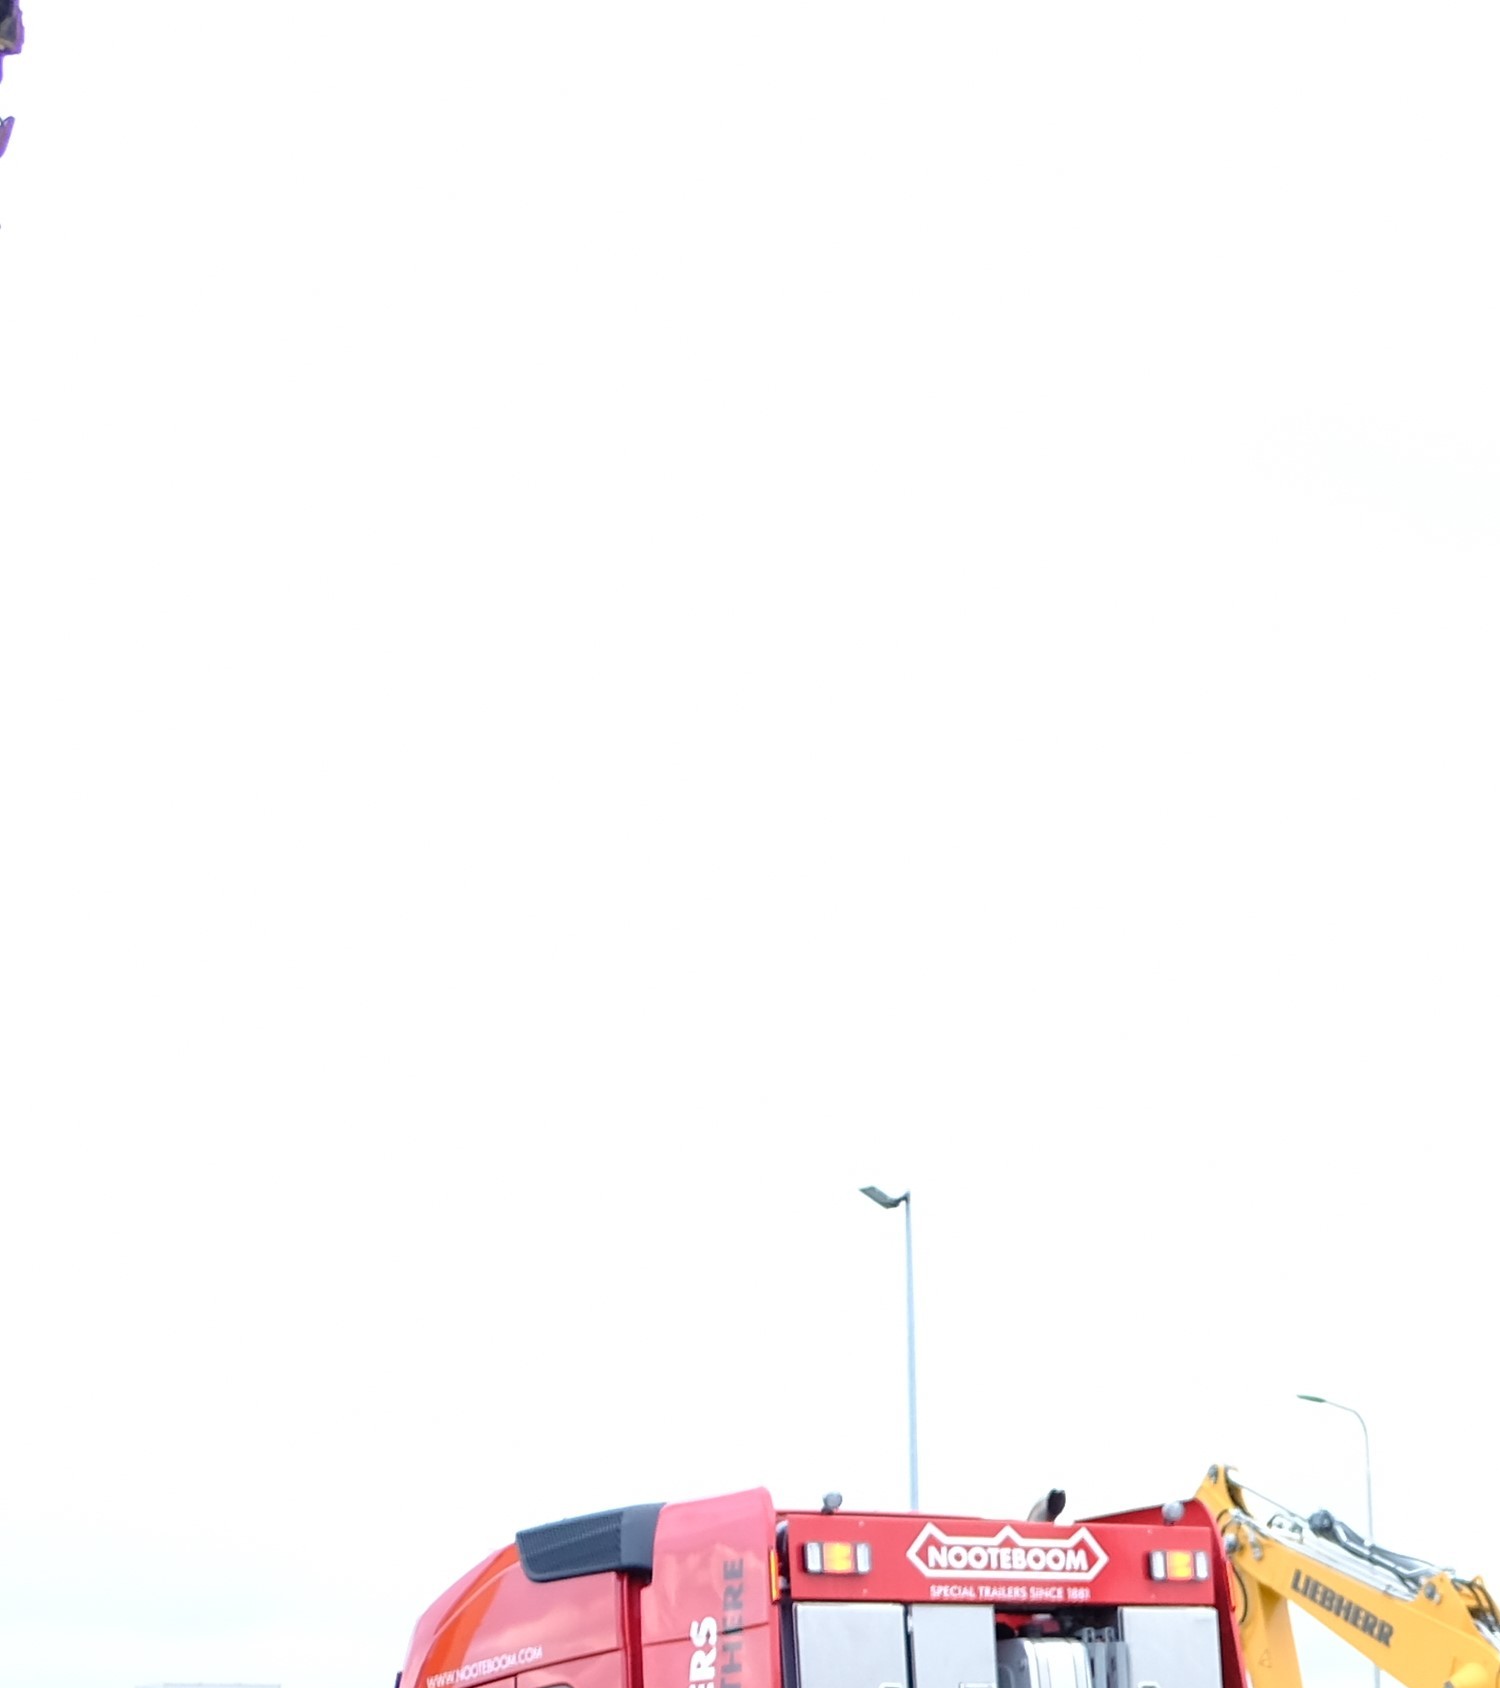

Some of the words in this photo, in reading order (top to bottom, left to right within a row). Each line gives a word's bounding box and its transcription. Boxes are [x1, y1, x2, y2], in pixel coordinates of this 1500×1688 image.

[927, 1545, 1089, 1571] NOOTEBOOM
[930, 1584, 976, 1600] SPECIAL
[979, 1584, 1028, 1600] TRAILERS
[1029, 1585, 1063, 1600] SINCE
[1290, 1567, 1395, 1649] LIEBHERR
